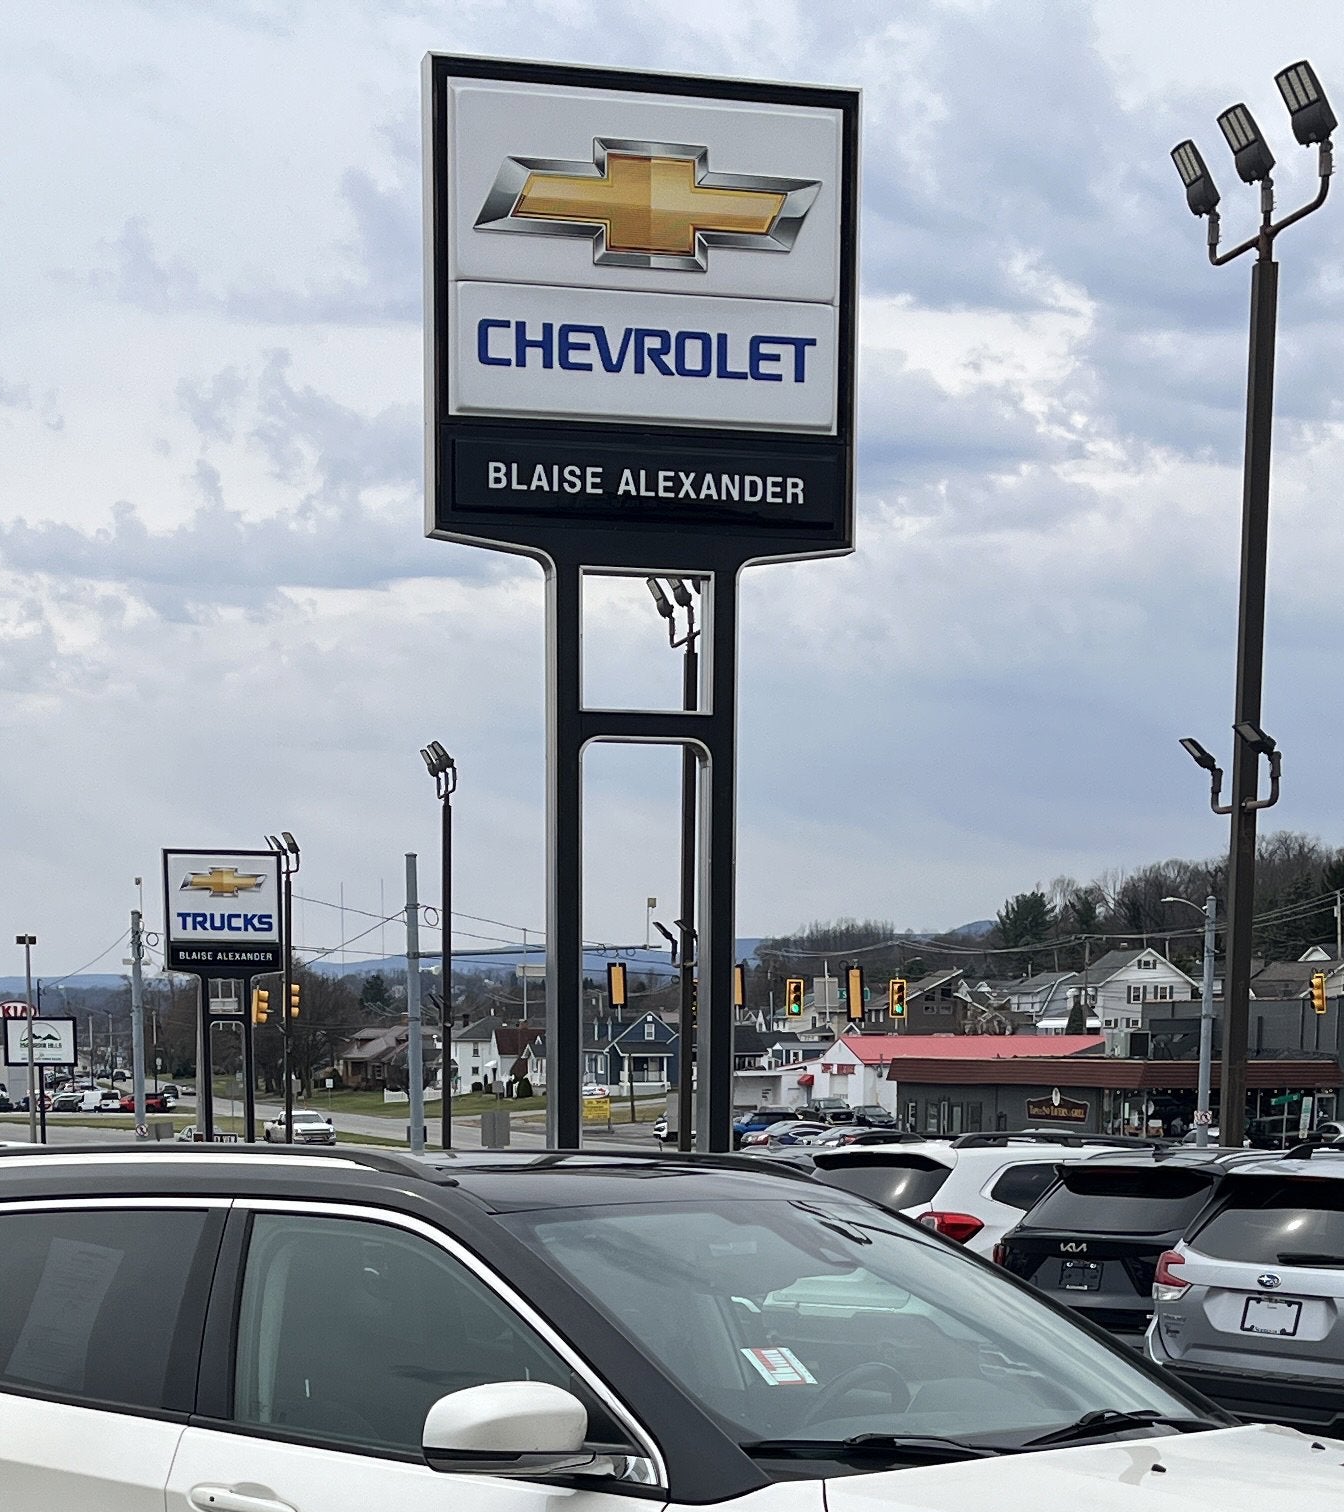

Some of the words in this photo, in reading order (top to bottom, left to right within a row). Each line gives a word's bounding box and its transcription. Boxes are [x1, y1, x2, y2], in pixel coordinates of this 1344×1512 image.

[477, 318, 817, 383] CHEVROLET
[487, 461, 603, 495] BLAISE
[617, 468, 805, 505] ALEXANDER
[177, 912, 273, 932] TRUCKS
[179, 951, 213, 961] BLAISE
[216, 952, 273, 961] ALEXANDER
